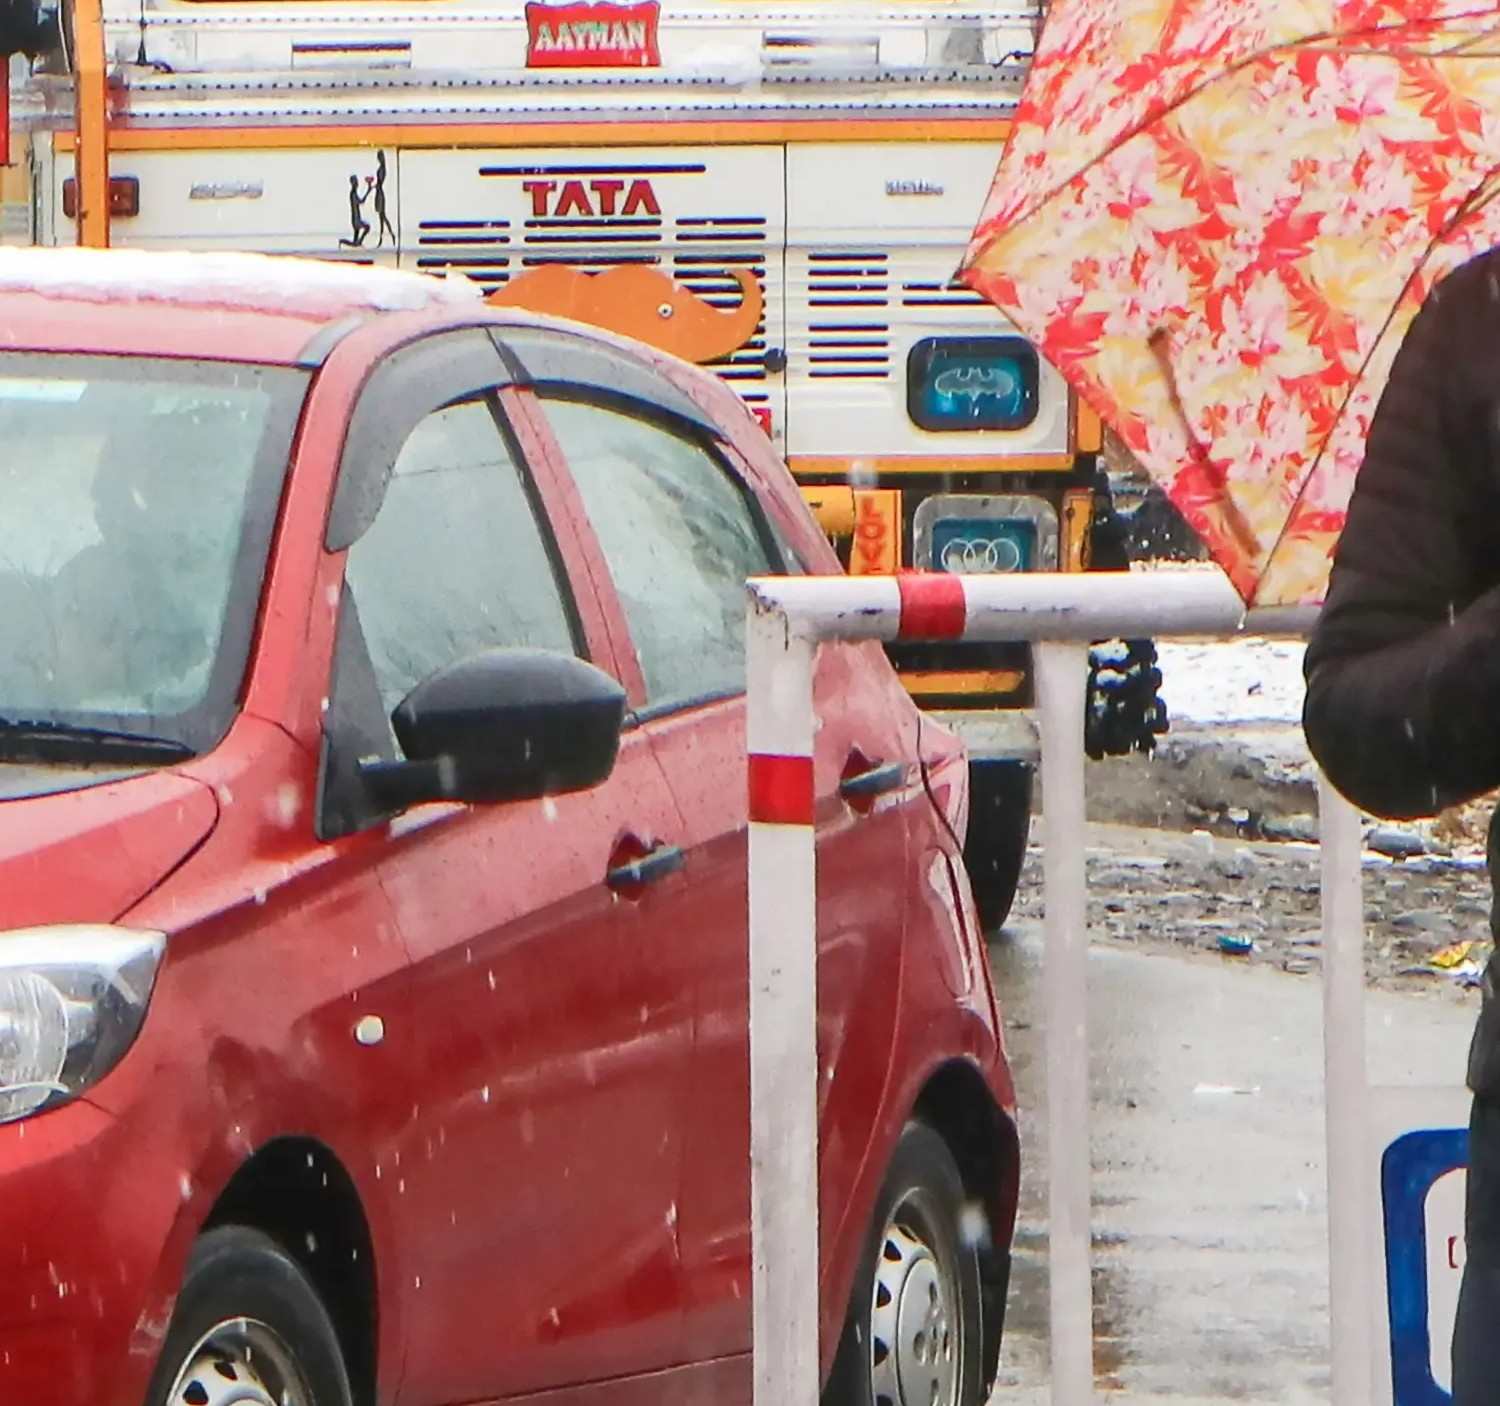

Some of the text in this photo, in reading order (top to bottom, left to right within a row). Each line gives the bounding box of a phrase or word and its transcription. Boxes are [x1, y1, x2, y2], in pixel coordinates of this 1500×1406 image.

[534, 19, 647, 51] AAYMAN
[522, 180, 662, 217] TATA
[856, 497, 887, 575] LOV
